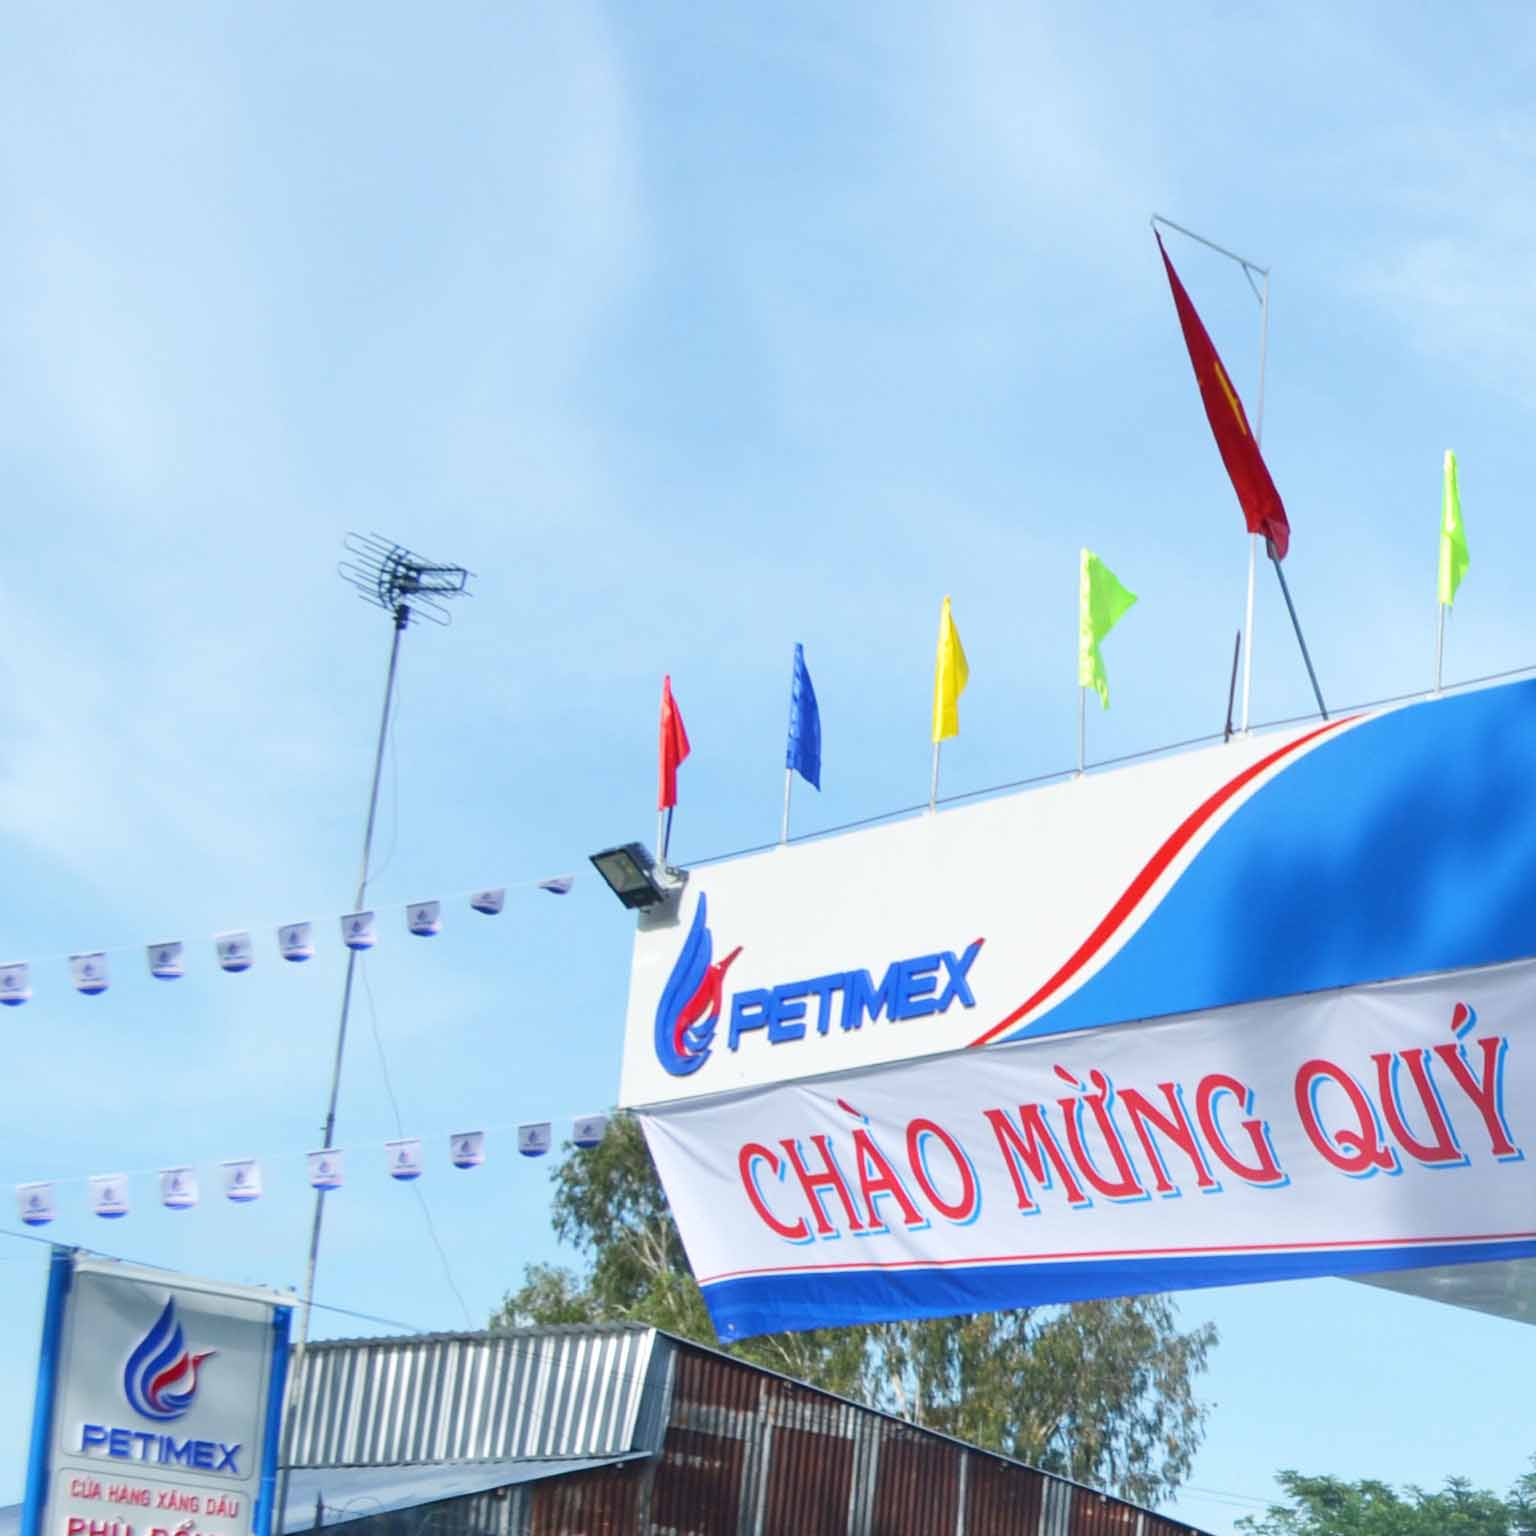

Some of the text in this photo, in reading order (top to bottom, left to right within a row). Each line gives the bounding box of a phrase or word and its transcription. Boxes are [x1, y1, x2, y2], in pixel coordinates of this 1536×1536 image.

[728, 937, 985, 1050] PETIMEX
[739, 1099, 982, 1245] CHÀO
[984, 1064, 1290, 1214] MỪNG
[1294, 1002, 1521, 1180] QUÝ
[81, 1424, 240, 1473] PETIMEX
[108, 1483, 151, 1507] HÀNG
[157, 1489, 200, 1513] XĂNG
